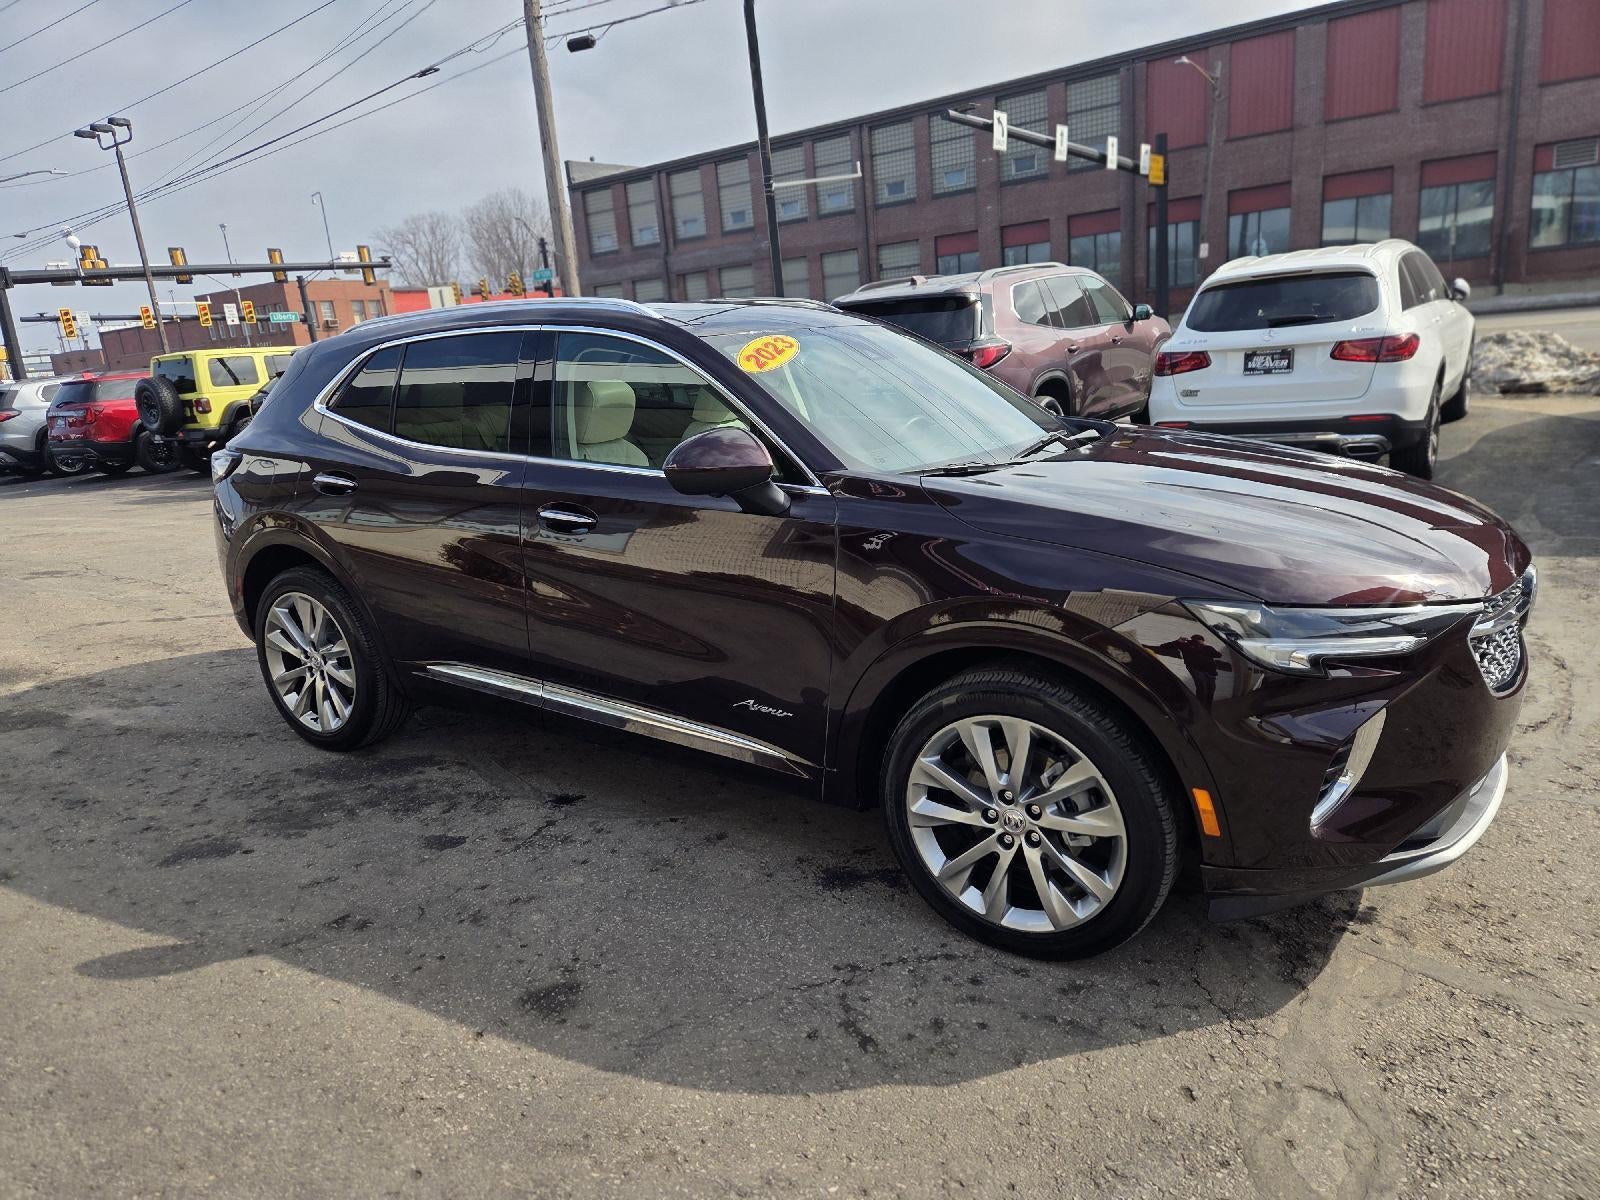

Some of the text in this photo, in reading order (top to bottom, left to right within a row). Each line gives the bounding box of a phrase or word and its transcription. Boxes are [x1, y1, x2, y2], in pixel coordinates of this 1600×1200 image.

[273, 312, 295, 321] Liberty
[743, 336, 795, 370] 2023
[1247, 359, 1289, 369] WEAVER
[732, 699, 794, 717] Avenir
